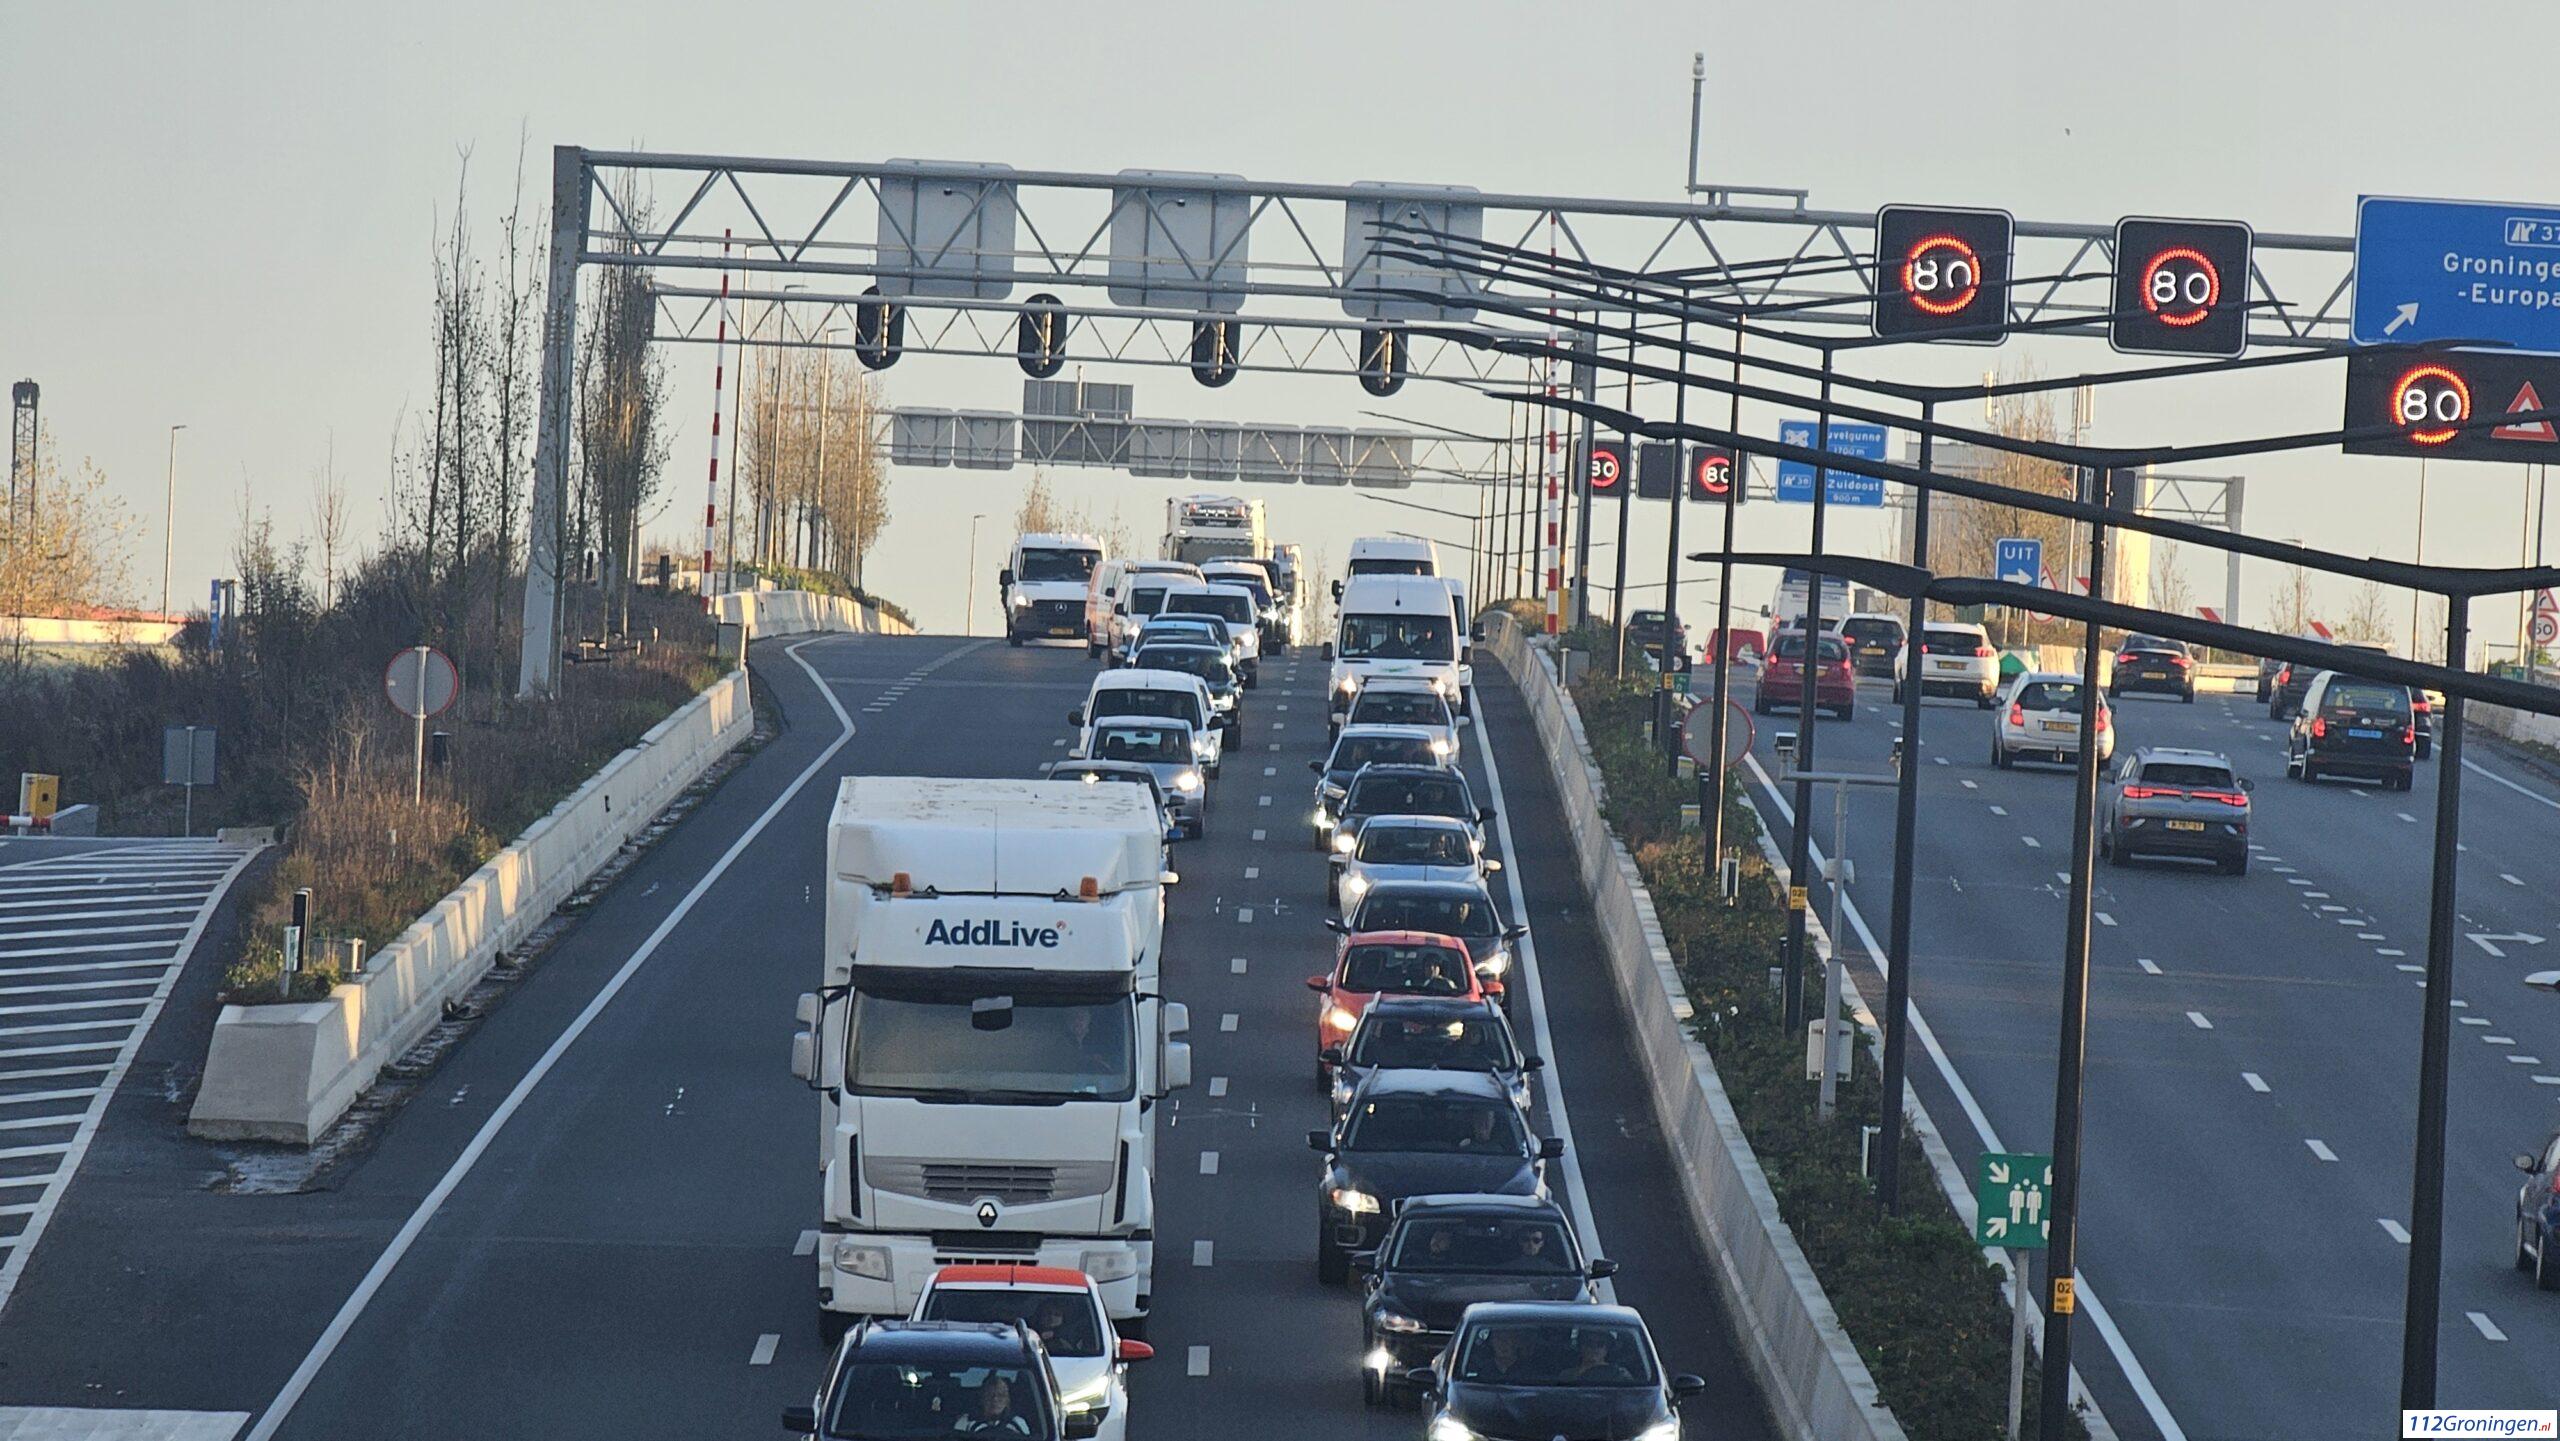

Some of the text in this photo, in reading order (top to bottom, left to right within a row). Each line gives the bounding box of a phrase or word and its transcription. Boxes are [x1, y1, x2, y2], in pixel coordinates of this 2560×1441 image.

[1913, 259, 1972, 292] 80
[2152, 270, 2211, 304] 80
[2403, 388, 2462, 422] 80
[1827, 478, 1880, 492] Zuidoost
[2004, 547, 2033, 560] UIT
[925, 919, 1059, 948] AddLive
